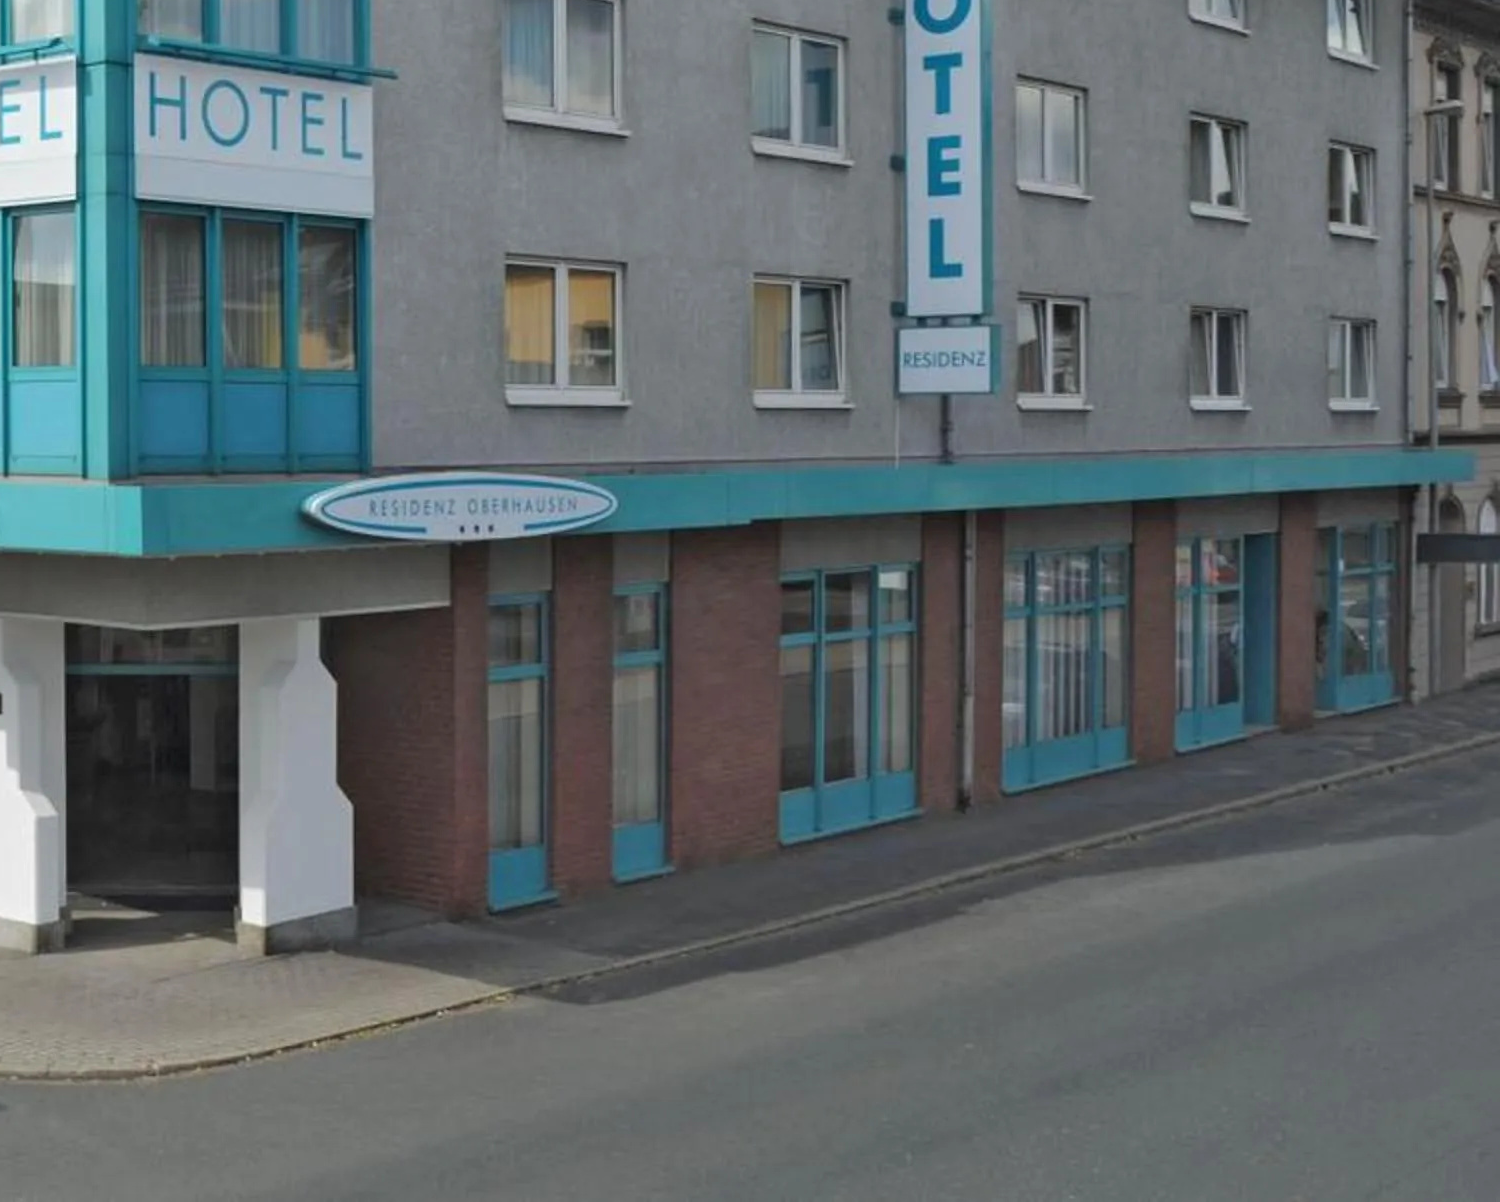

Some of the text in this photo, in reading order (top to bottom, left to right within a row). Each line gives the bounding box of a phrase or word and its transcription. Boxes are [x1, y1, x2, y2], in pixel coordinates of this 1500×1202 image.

[148, 71, 364, 161] HOTEL
[903, 349, 987, 367] RESIDENZ
[369, 497, 578, 517] RESIDENZ OBERHAUSEN
